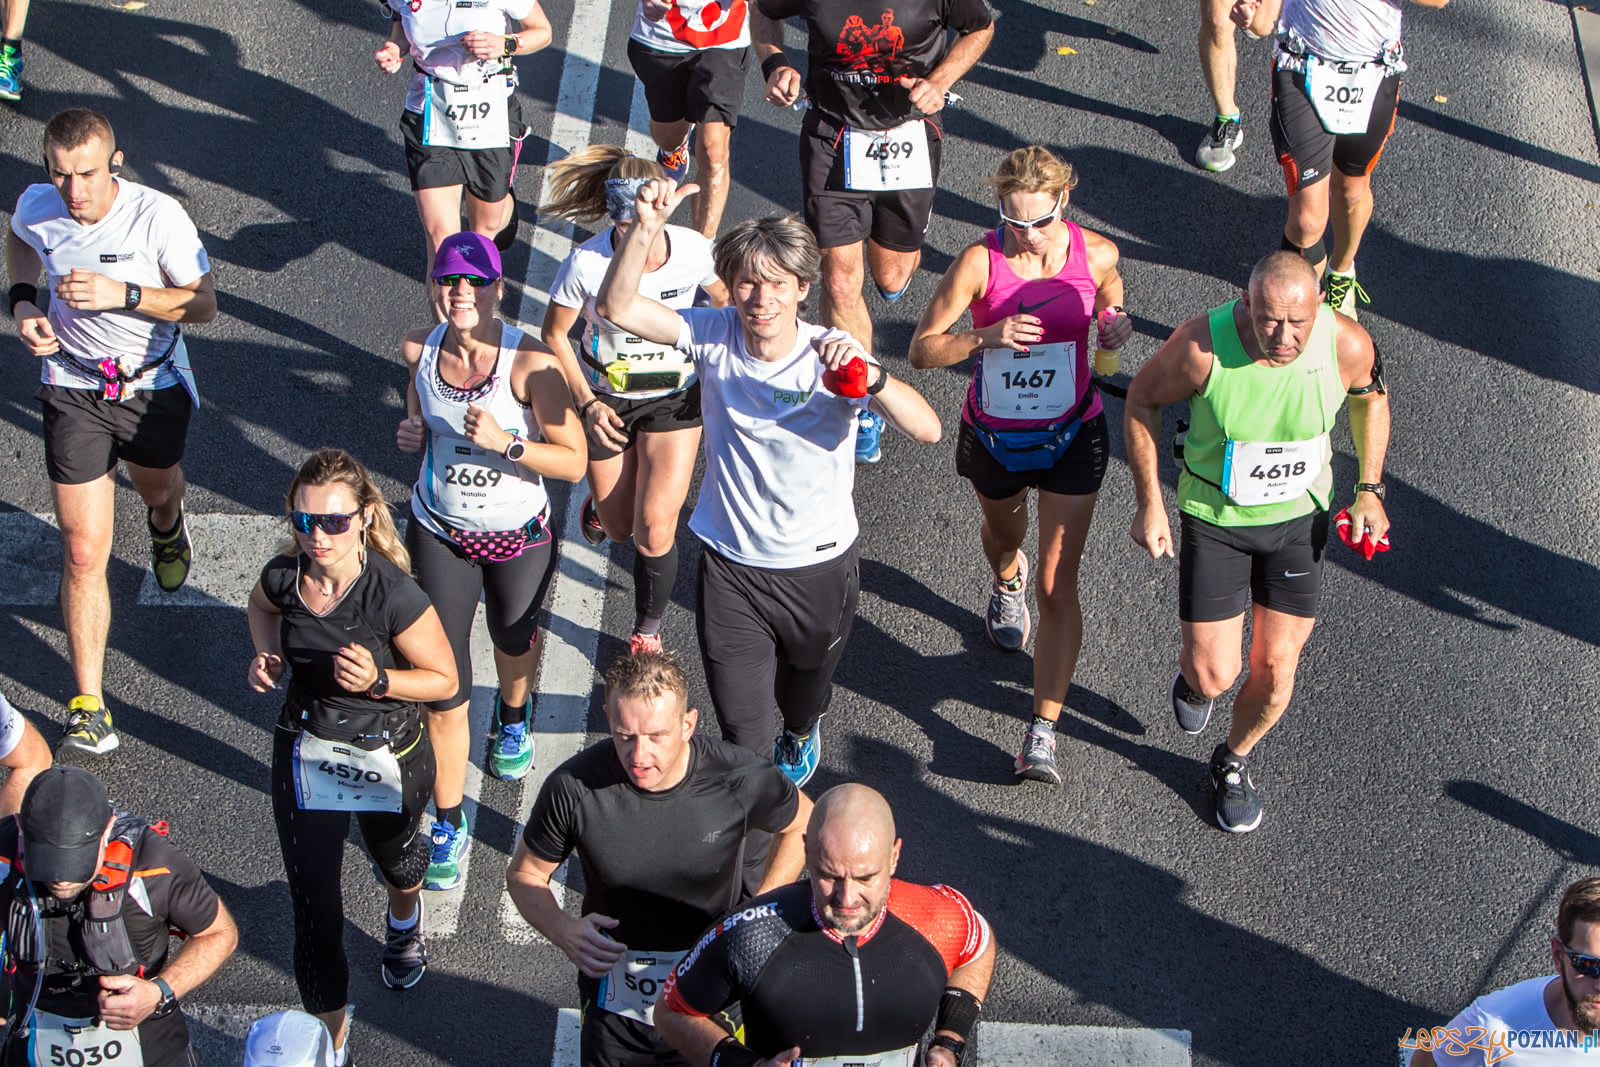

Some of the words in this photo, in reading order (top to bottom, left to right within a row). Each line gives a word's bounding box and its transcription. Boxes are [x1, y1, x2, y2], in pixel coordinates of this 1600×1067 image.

[445, 102, 491, 121] 4719
[865, 141, 913, 161] 4599
[1001, 369, 1056, 389] 1467
[445, 465, 502, 487] 2669
[1250, 461, 1306, 480] 4618
[460, 490, 487, 498] Natalia
[319, 760, 382, 783] 4570
[624, 971, 667, 996] 50
[50, 1040, 122, 1067] 5030
